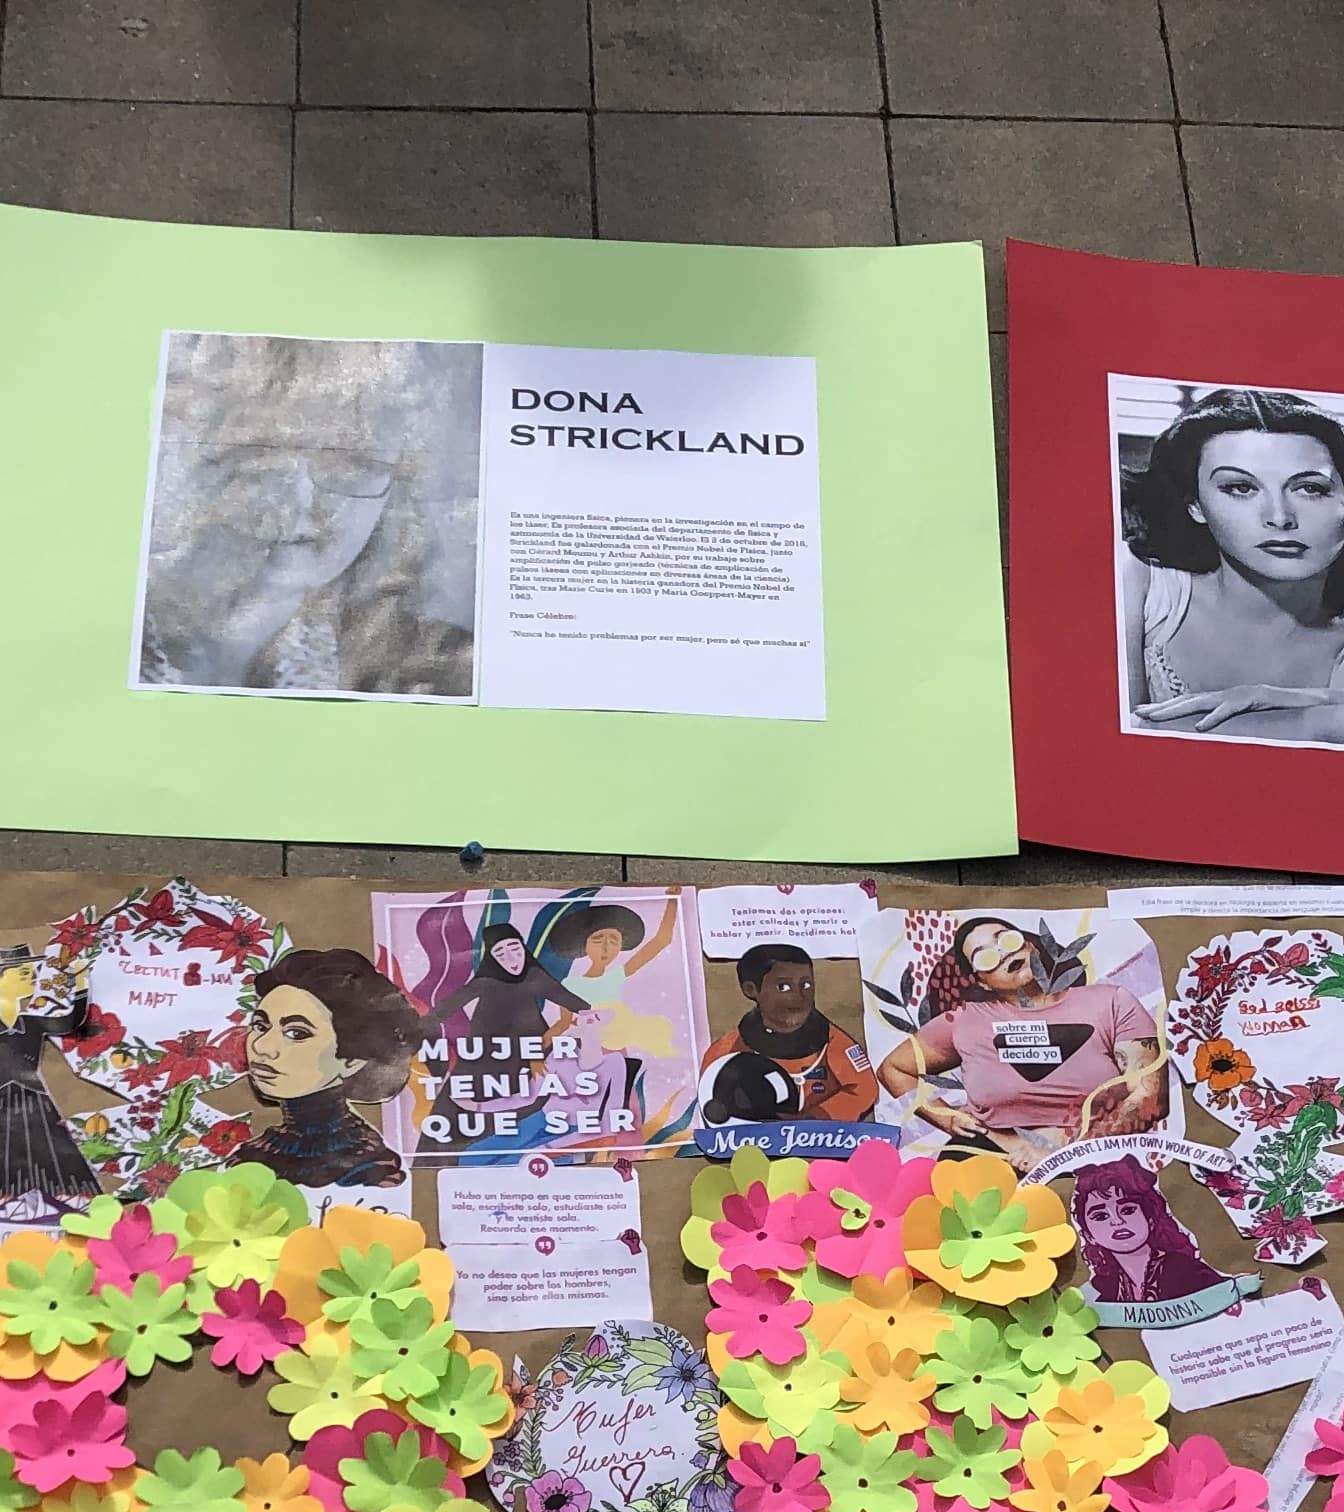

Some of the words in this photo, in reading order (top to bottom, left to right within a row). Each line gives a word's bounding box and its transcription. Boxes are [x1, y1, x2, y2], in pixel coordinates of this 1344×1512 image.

[512, 389, 643, 414] DONA
[510, 425, 804, 455] STRICKLAND
[996, 1023, 1024, 1034] sobre
[1027, 1023, 1045, 1033] mi
[1009, 1033, 1047, 1044] cuerpo
[419, 1035, 582, 1063] MUJER
[1002, 1048, 1039, 1061] decido
[1043, 1049, 1058, 1061] yo
[419, 1071, 600, 1100] TENÍAS
[421, 1112, 519, 1138] QUE
[545, 1109, 635, 1134] SER
[707, 1128, 768, 1151] Mae
[1124, 1301, 1204, 1324] MADONNA
